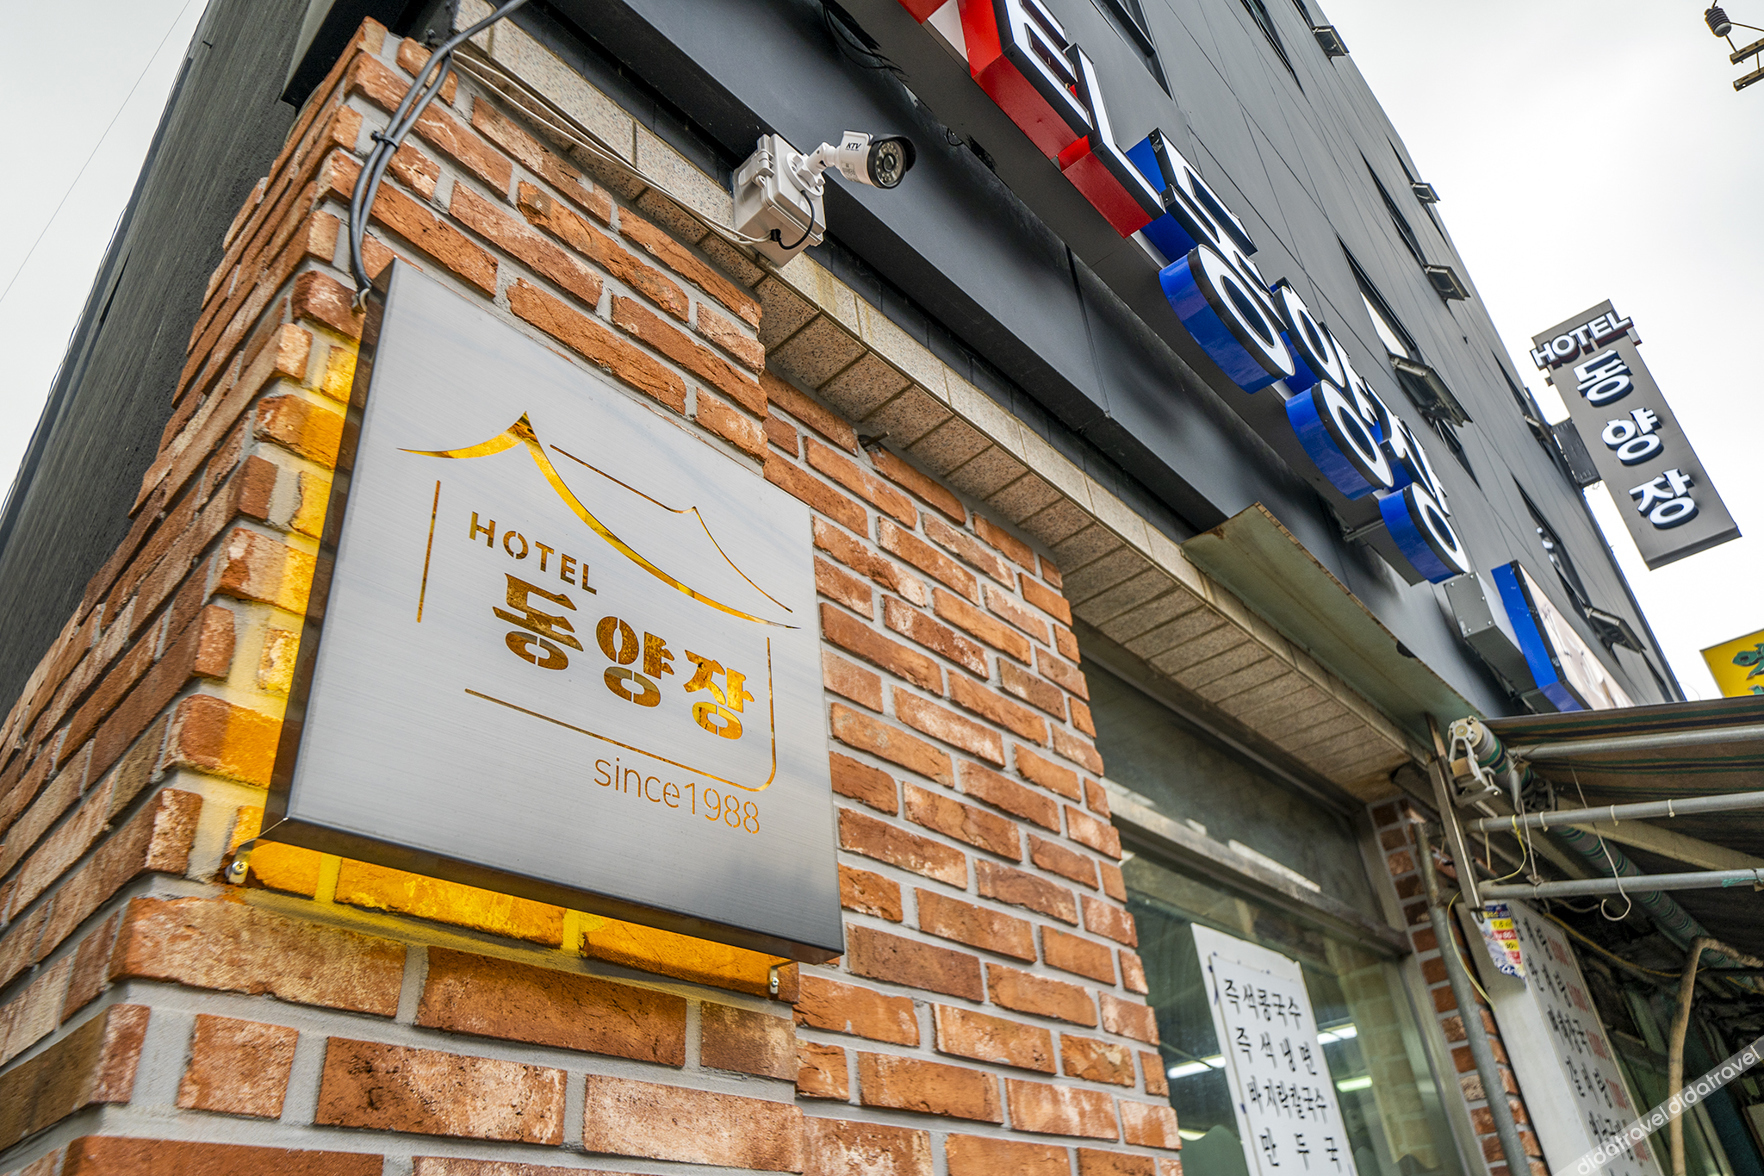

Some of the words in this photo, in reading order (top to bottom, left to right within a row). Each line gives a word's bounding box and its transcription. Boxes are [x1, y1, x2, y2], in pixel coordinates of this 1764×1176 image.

[1531, 311, 1631, 367] HOTEL
[1573, 349, 1695, 524] 동양장
[468, 511, 597, 595] HOTEL
[492, 572, 755, 740] 동양장
[1223, 978, 1302, 1030] 즉석콩국수
